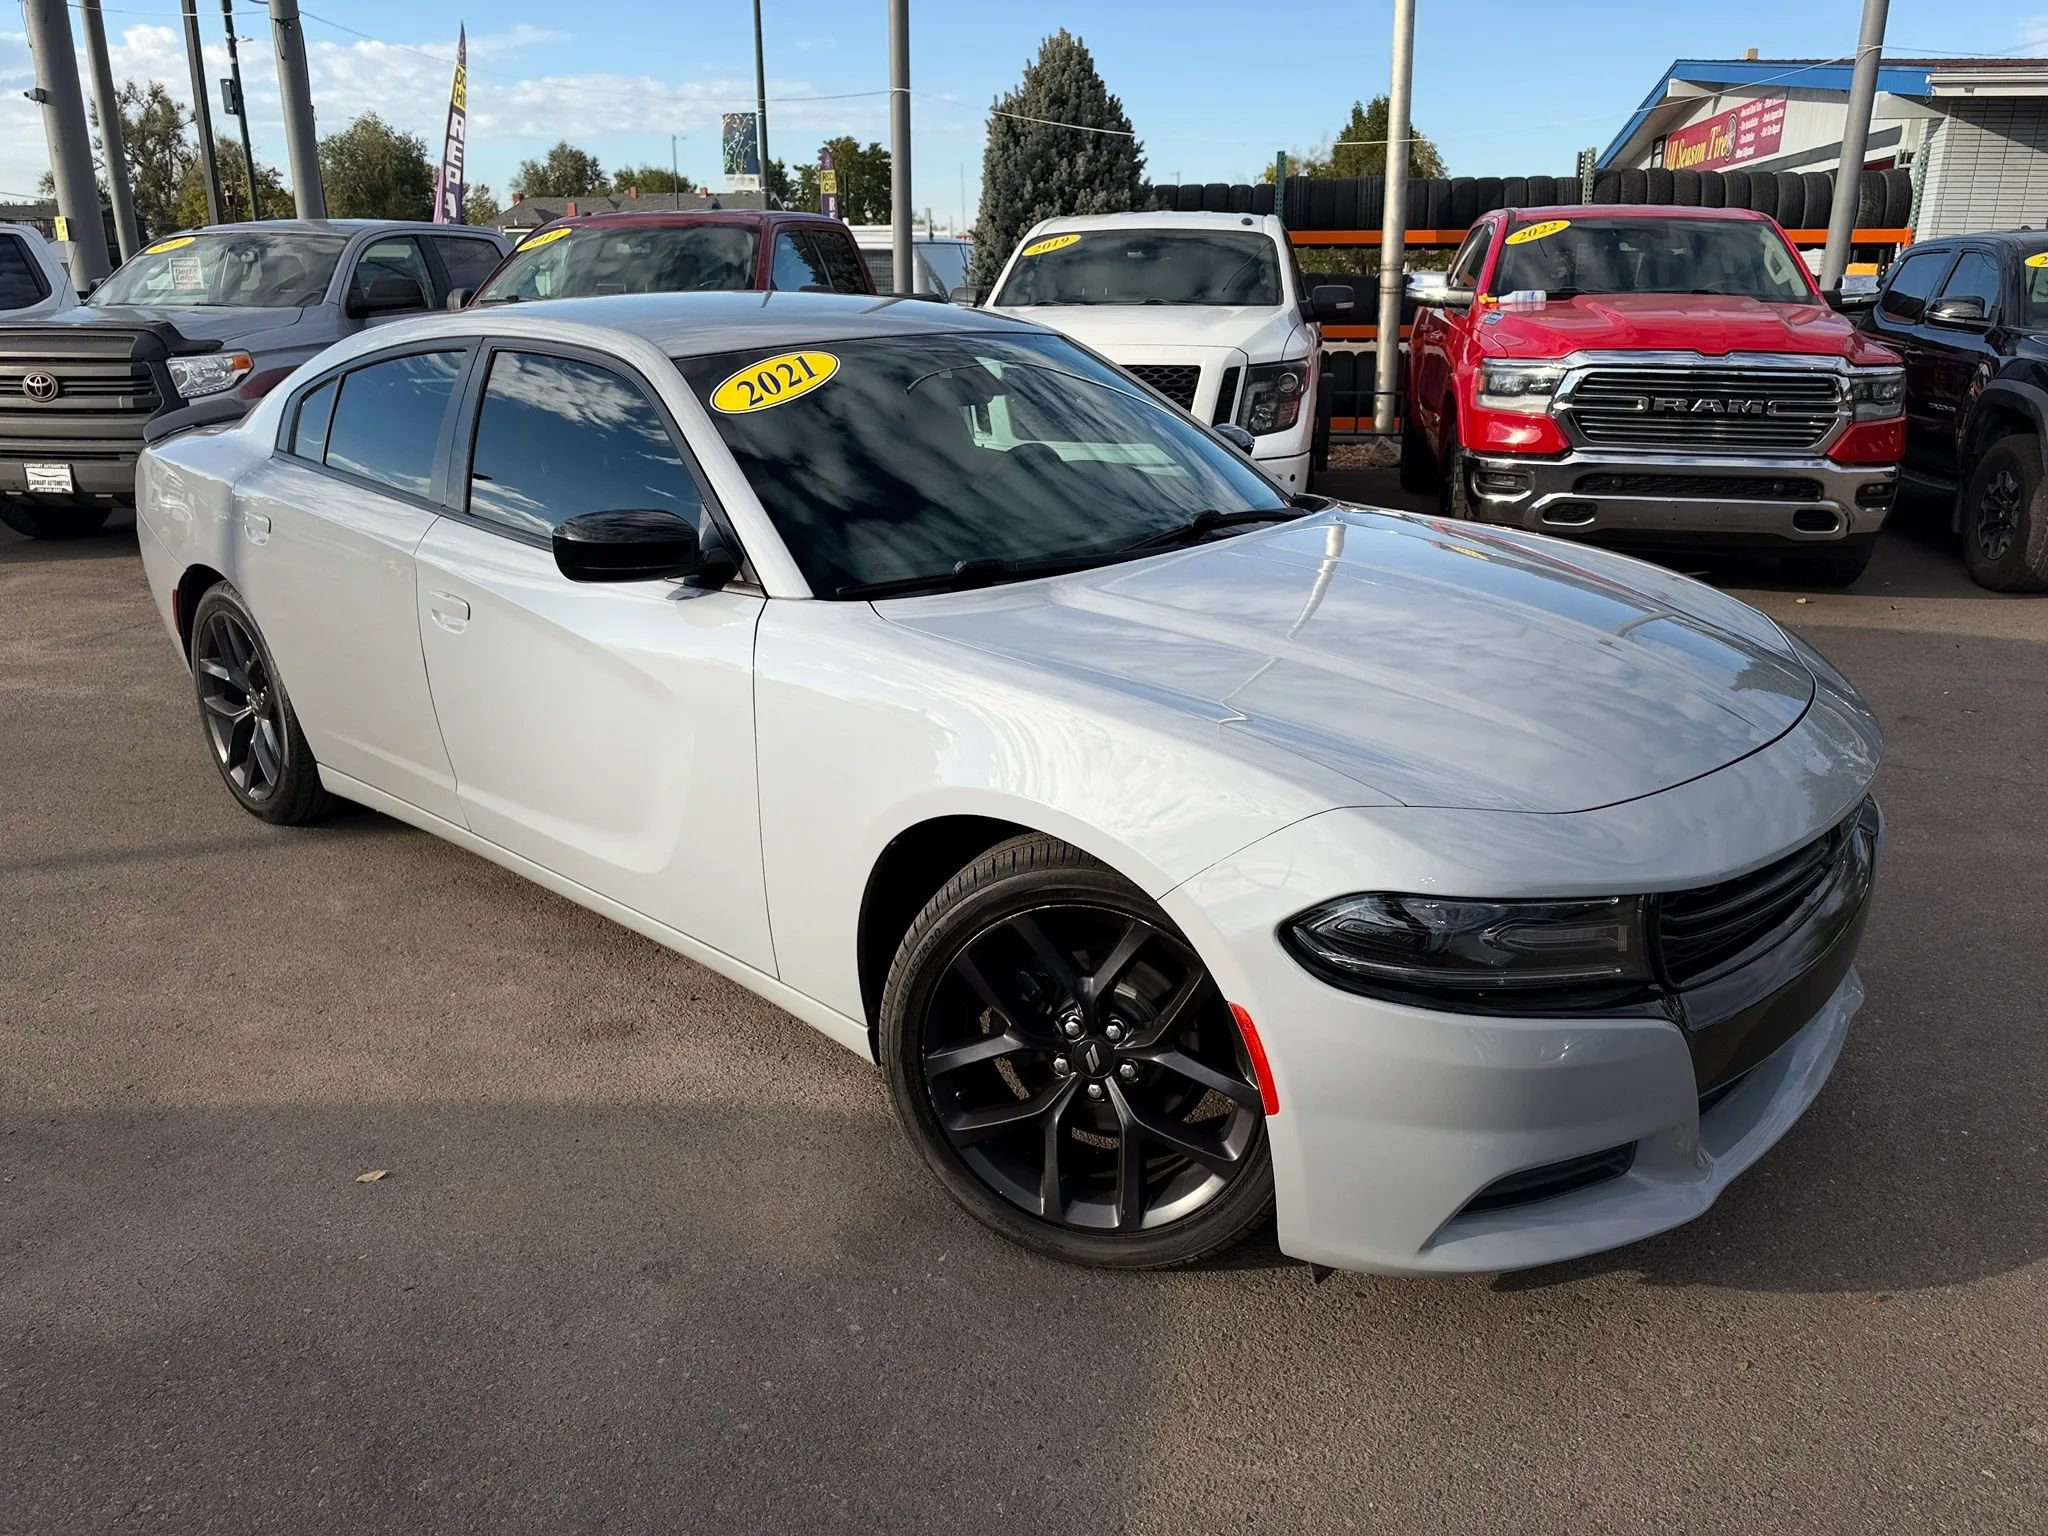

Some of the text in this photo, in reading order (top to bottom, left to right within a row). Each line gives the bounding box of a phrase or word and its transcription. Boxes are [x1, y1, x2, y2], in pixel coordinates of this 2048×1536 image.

[1676, 137, 1706, 168] Season
[1519, 222, 1558, 241] 2022
[1033, 237, 1070, 253] 2019
[736, 355, 819, 407] 2021
[1653, 397, 1764, 414] RAM
